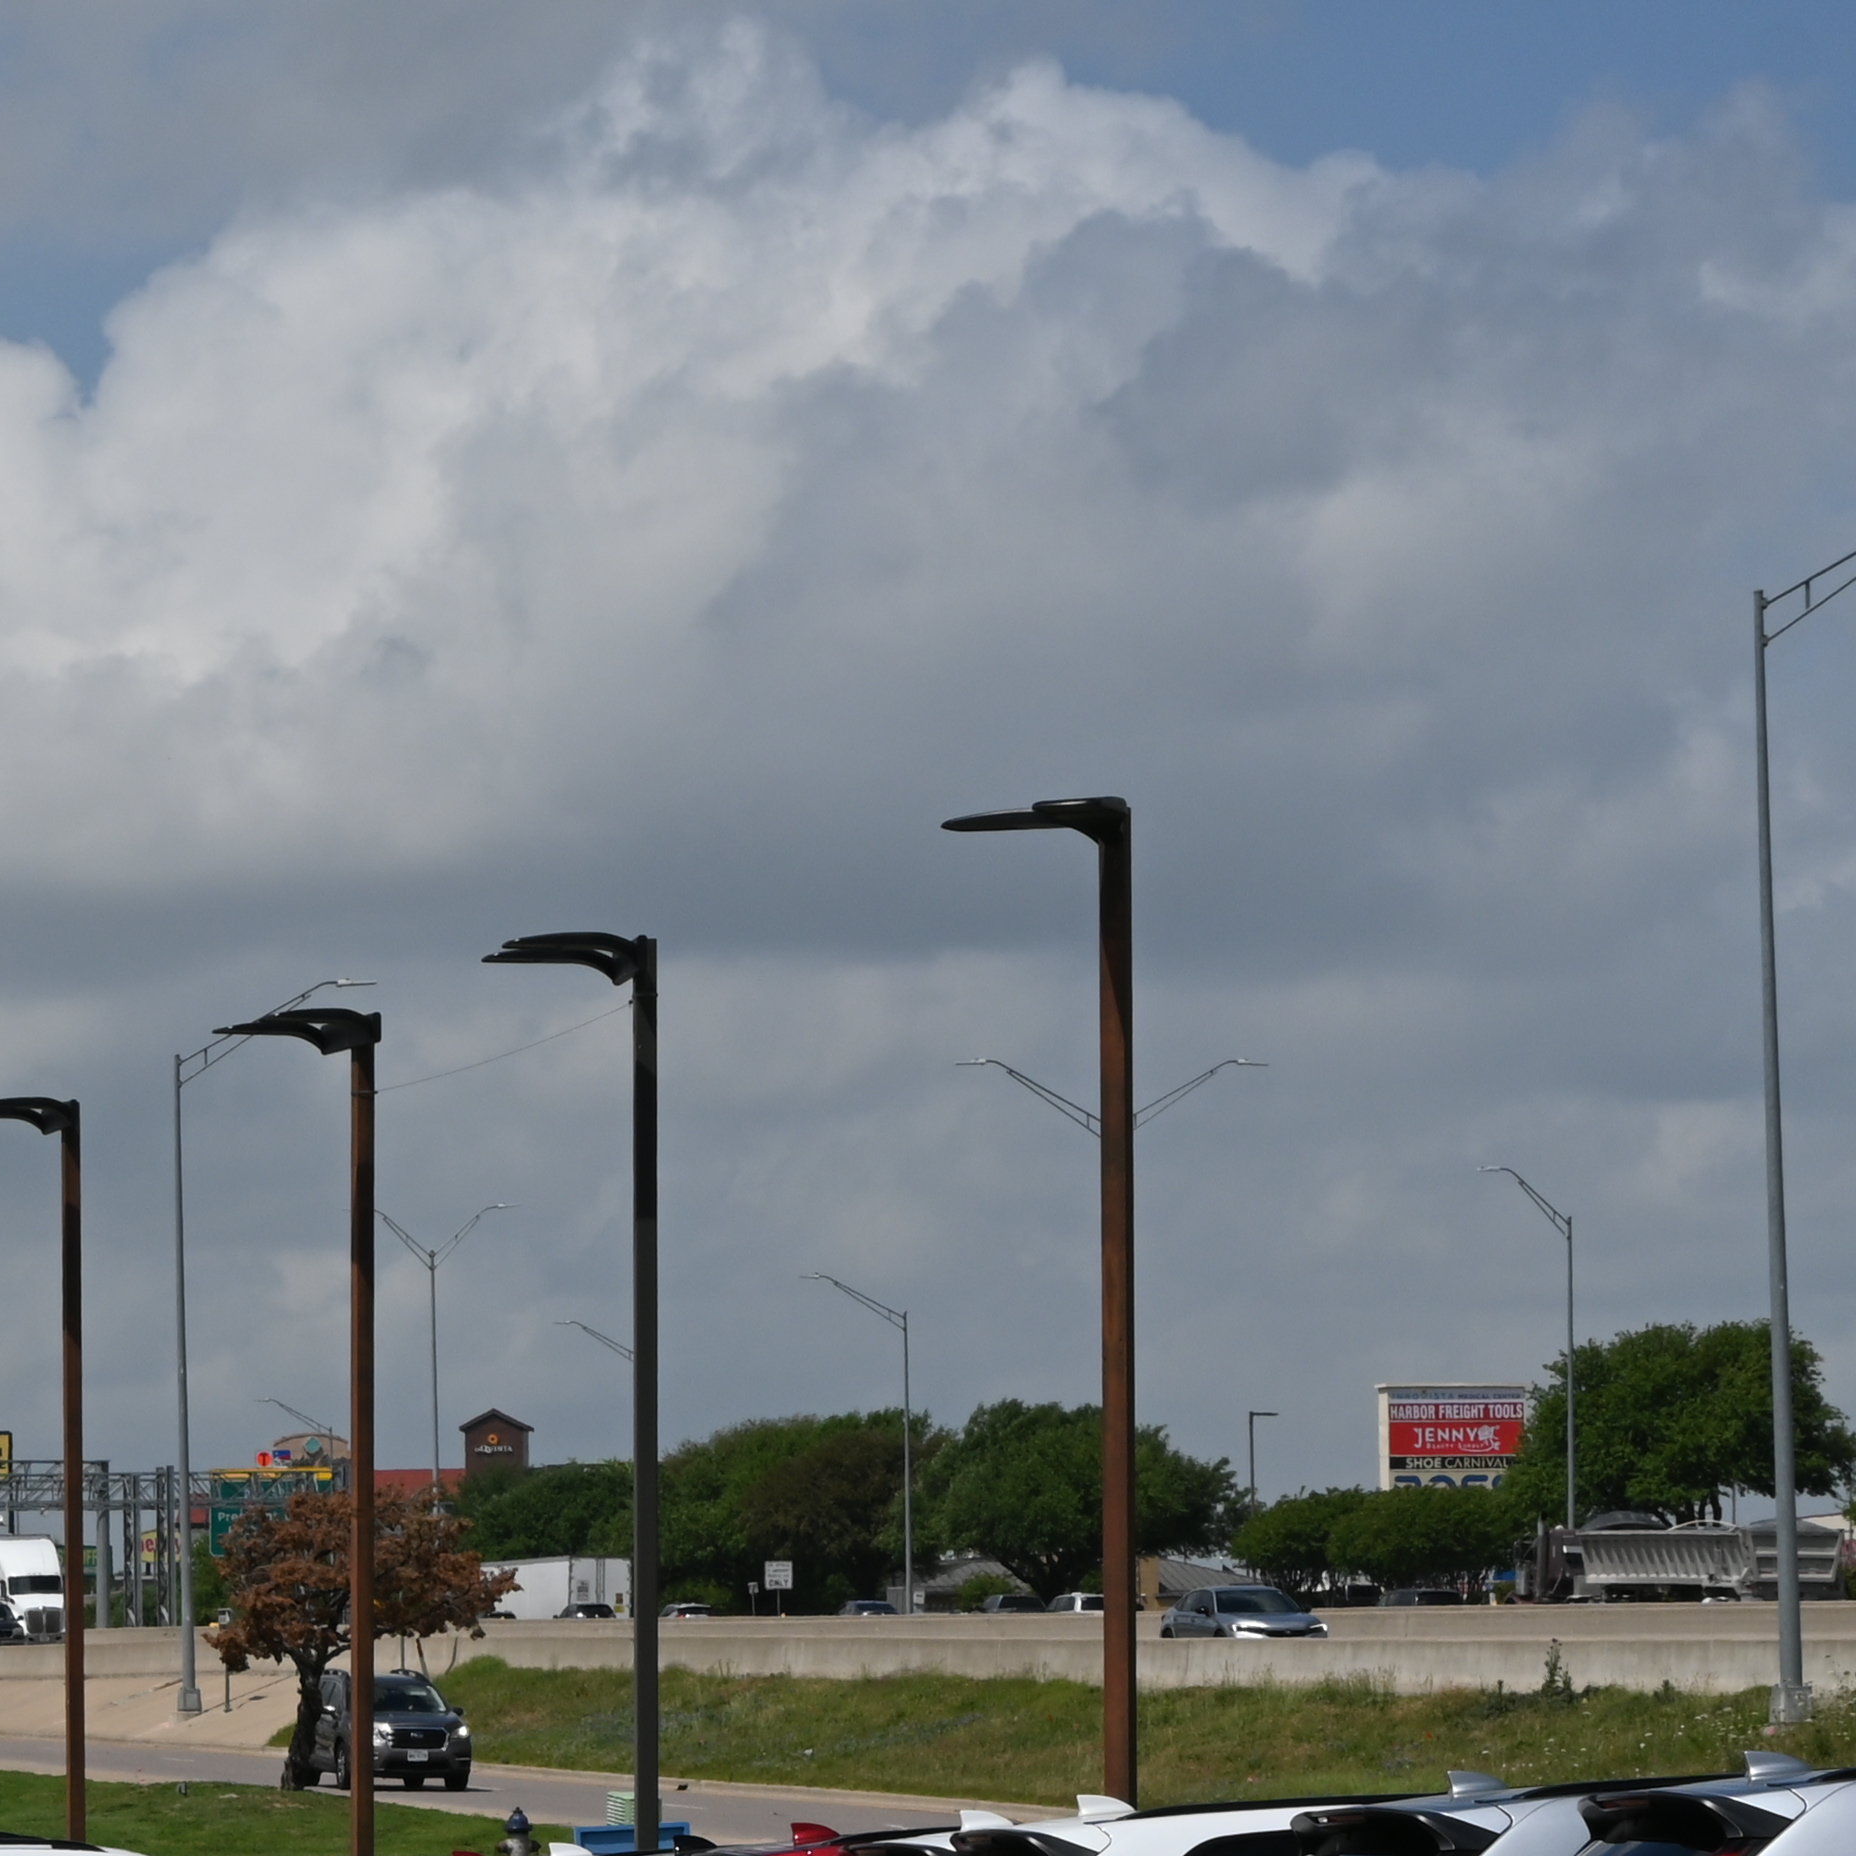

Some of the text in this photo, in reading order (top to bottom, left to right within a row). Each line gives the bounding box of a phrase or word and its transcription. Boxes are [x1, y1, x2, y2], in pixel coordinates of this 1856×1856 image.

[1390, 1404, 1523, 1419] HARBOR FREIGHT TOOLS
[1413, 1427, 1478, 1449] JENNY
[1405, 1457, 1508, 1469] SHOE CARNIVAL
